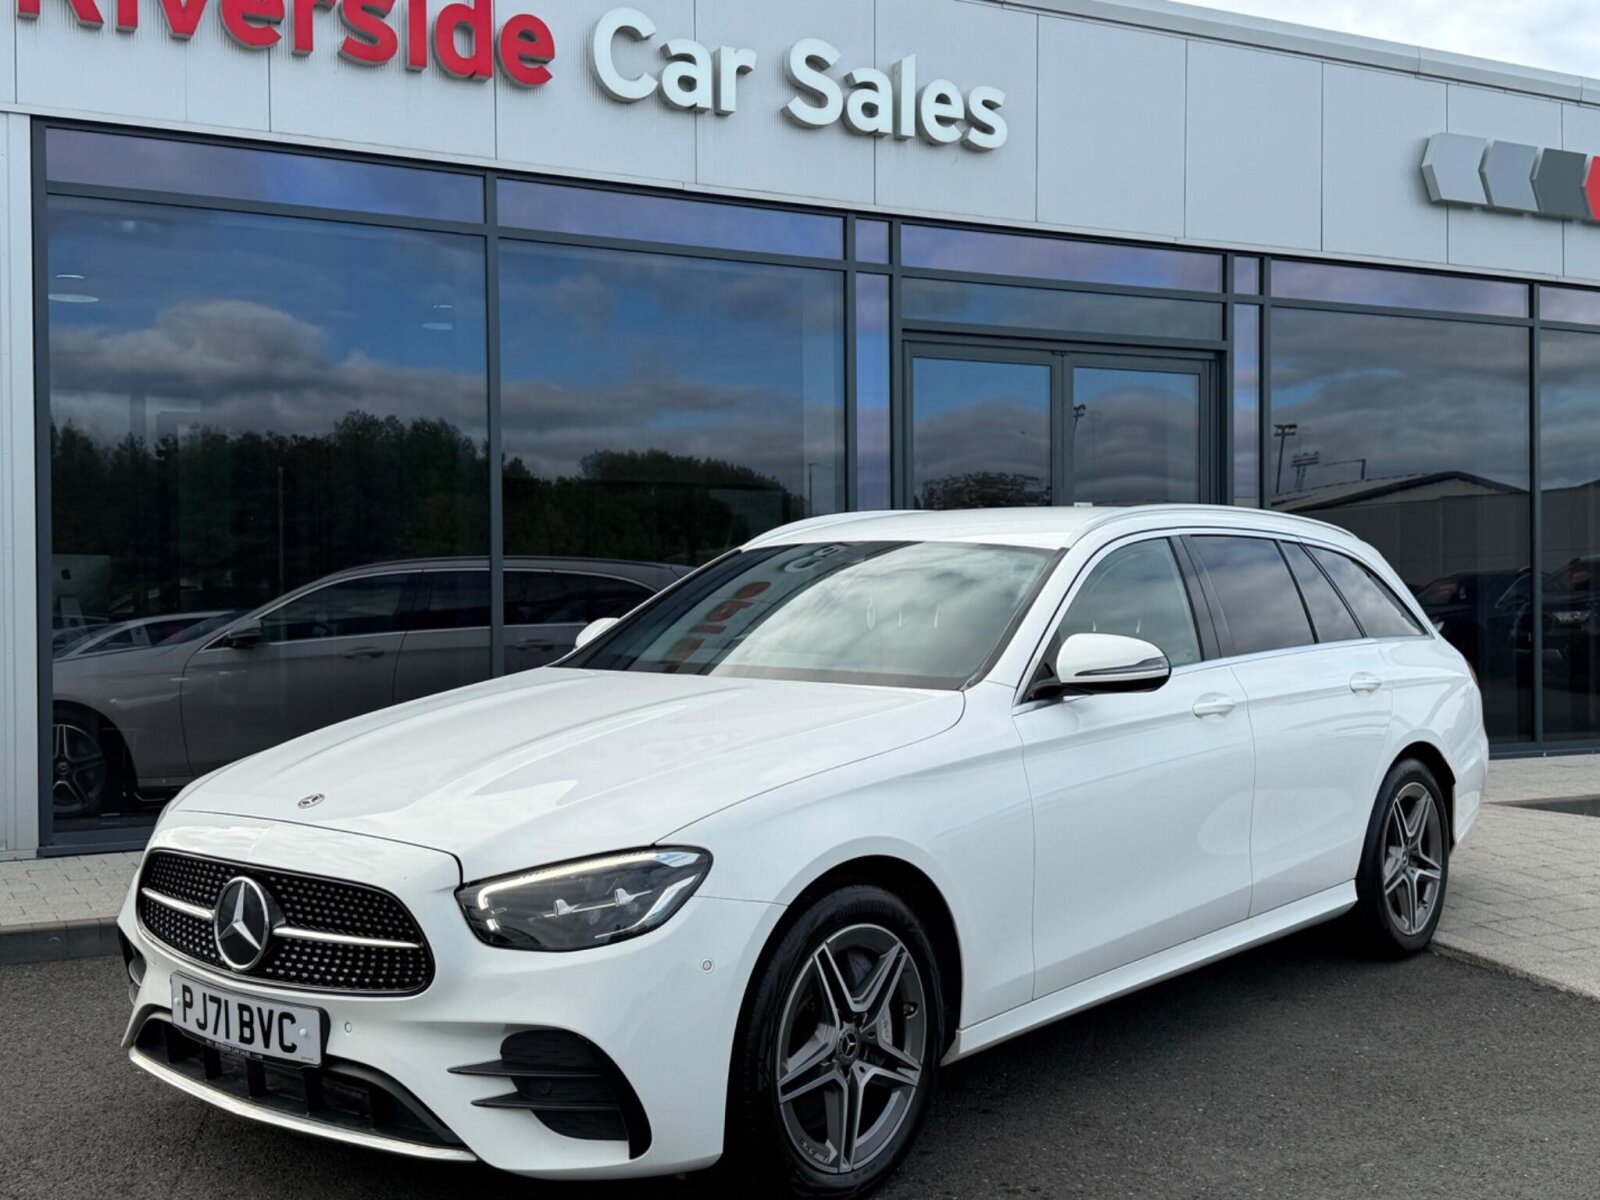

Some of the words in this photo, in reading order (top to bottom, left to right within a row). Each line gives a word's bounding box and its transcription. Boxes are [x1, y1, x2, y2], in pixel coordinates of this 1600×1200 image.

[17, 0, 556, 88] verside
[589, 7, 757, 116] Car
[781, 38, 1008, 152] Sales
[181, 983, 231, 1040] PJ71
[237, 1002, 298, 1054] BVC
